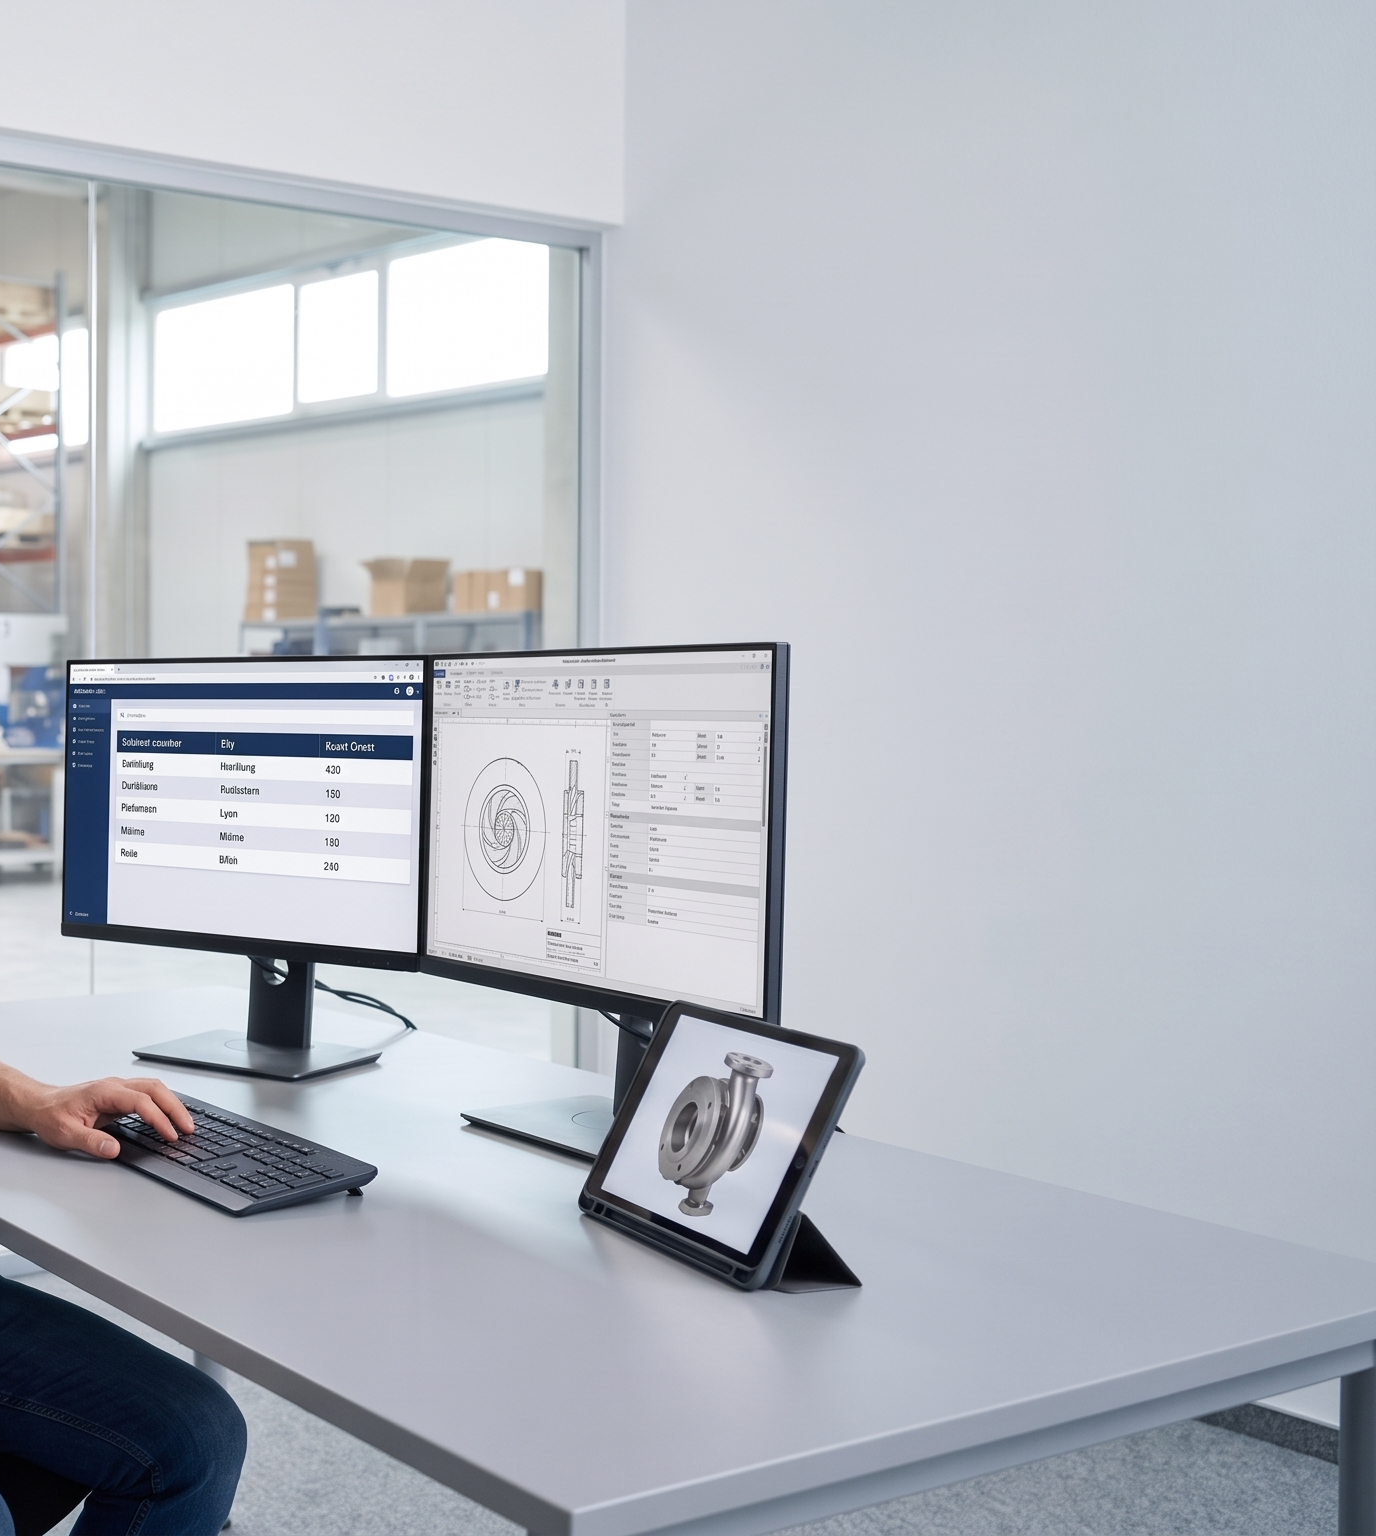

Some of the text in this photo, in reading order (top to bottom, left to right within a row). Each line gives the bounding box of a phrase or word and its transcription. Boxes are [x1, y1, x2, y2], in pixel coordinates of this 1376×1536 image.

[325, 789, 341, 799] 150
[219, 808, 238, 819] Lyon
[325, 813, 340, 823] 120
[324, 837, 340, 847] 180
